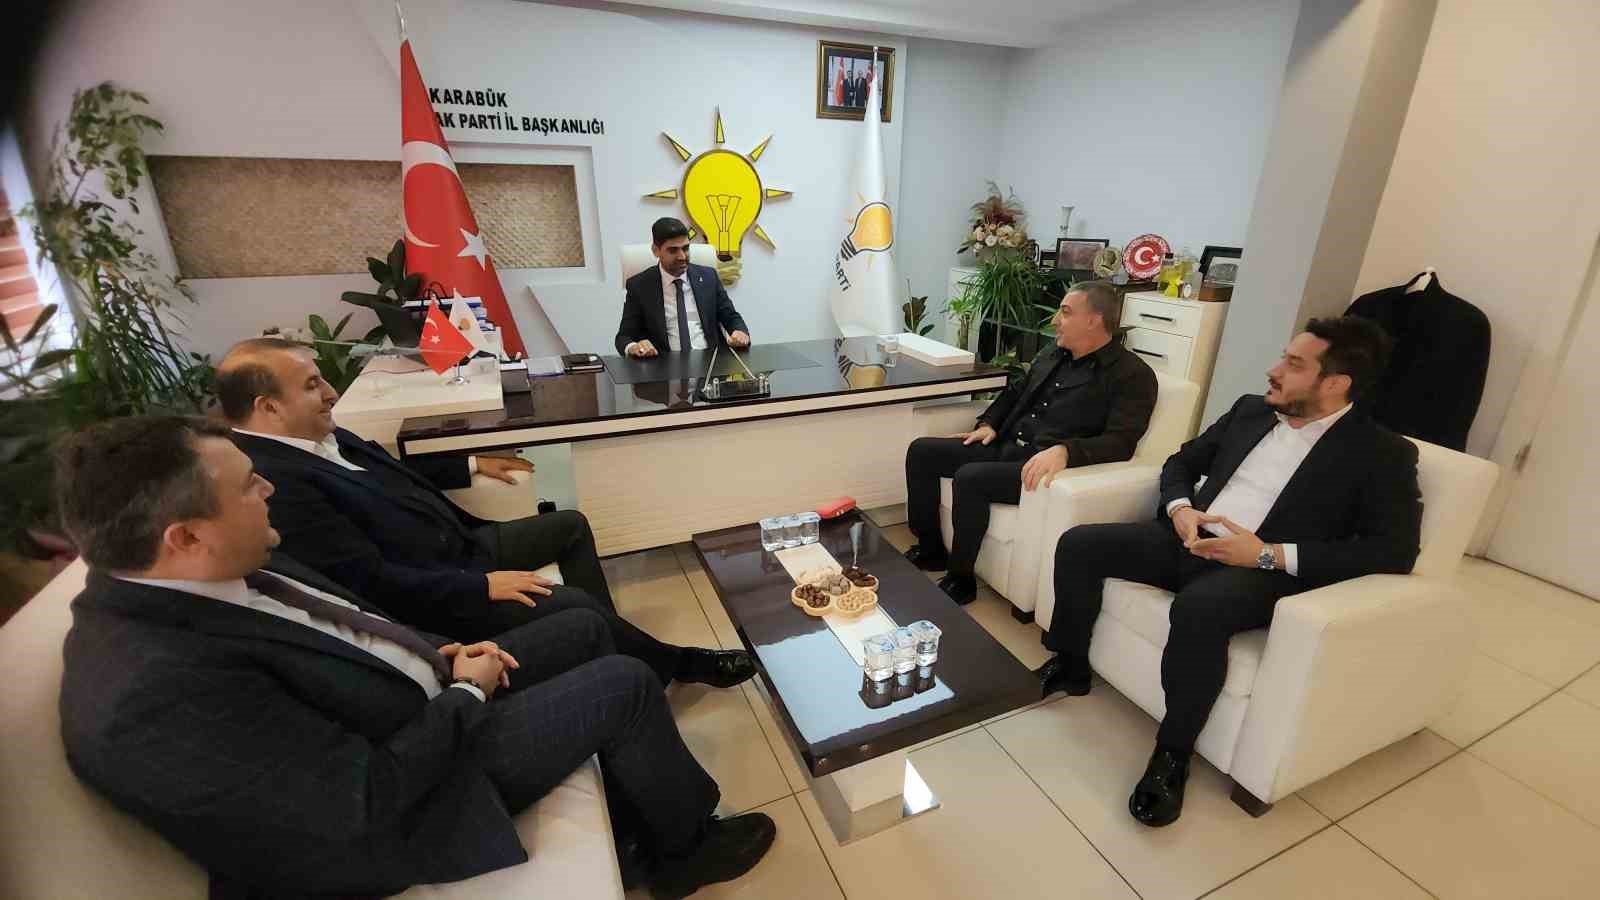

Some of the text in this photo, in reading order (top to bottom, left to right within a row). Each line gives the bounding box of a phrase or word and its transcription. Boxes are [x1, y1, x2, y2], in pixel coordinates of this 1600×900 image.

[429, 87, 508, 108] KARABÜK
[459, 111, 502, 130] PARTİ
[504, 111, 519, 131] İL
[521, 116, 605, 136] BAŞKANLIĞI
